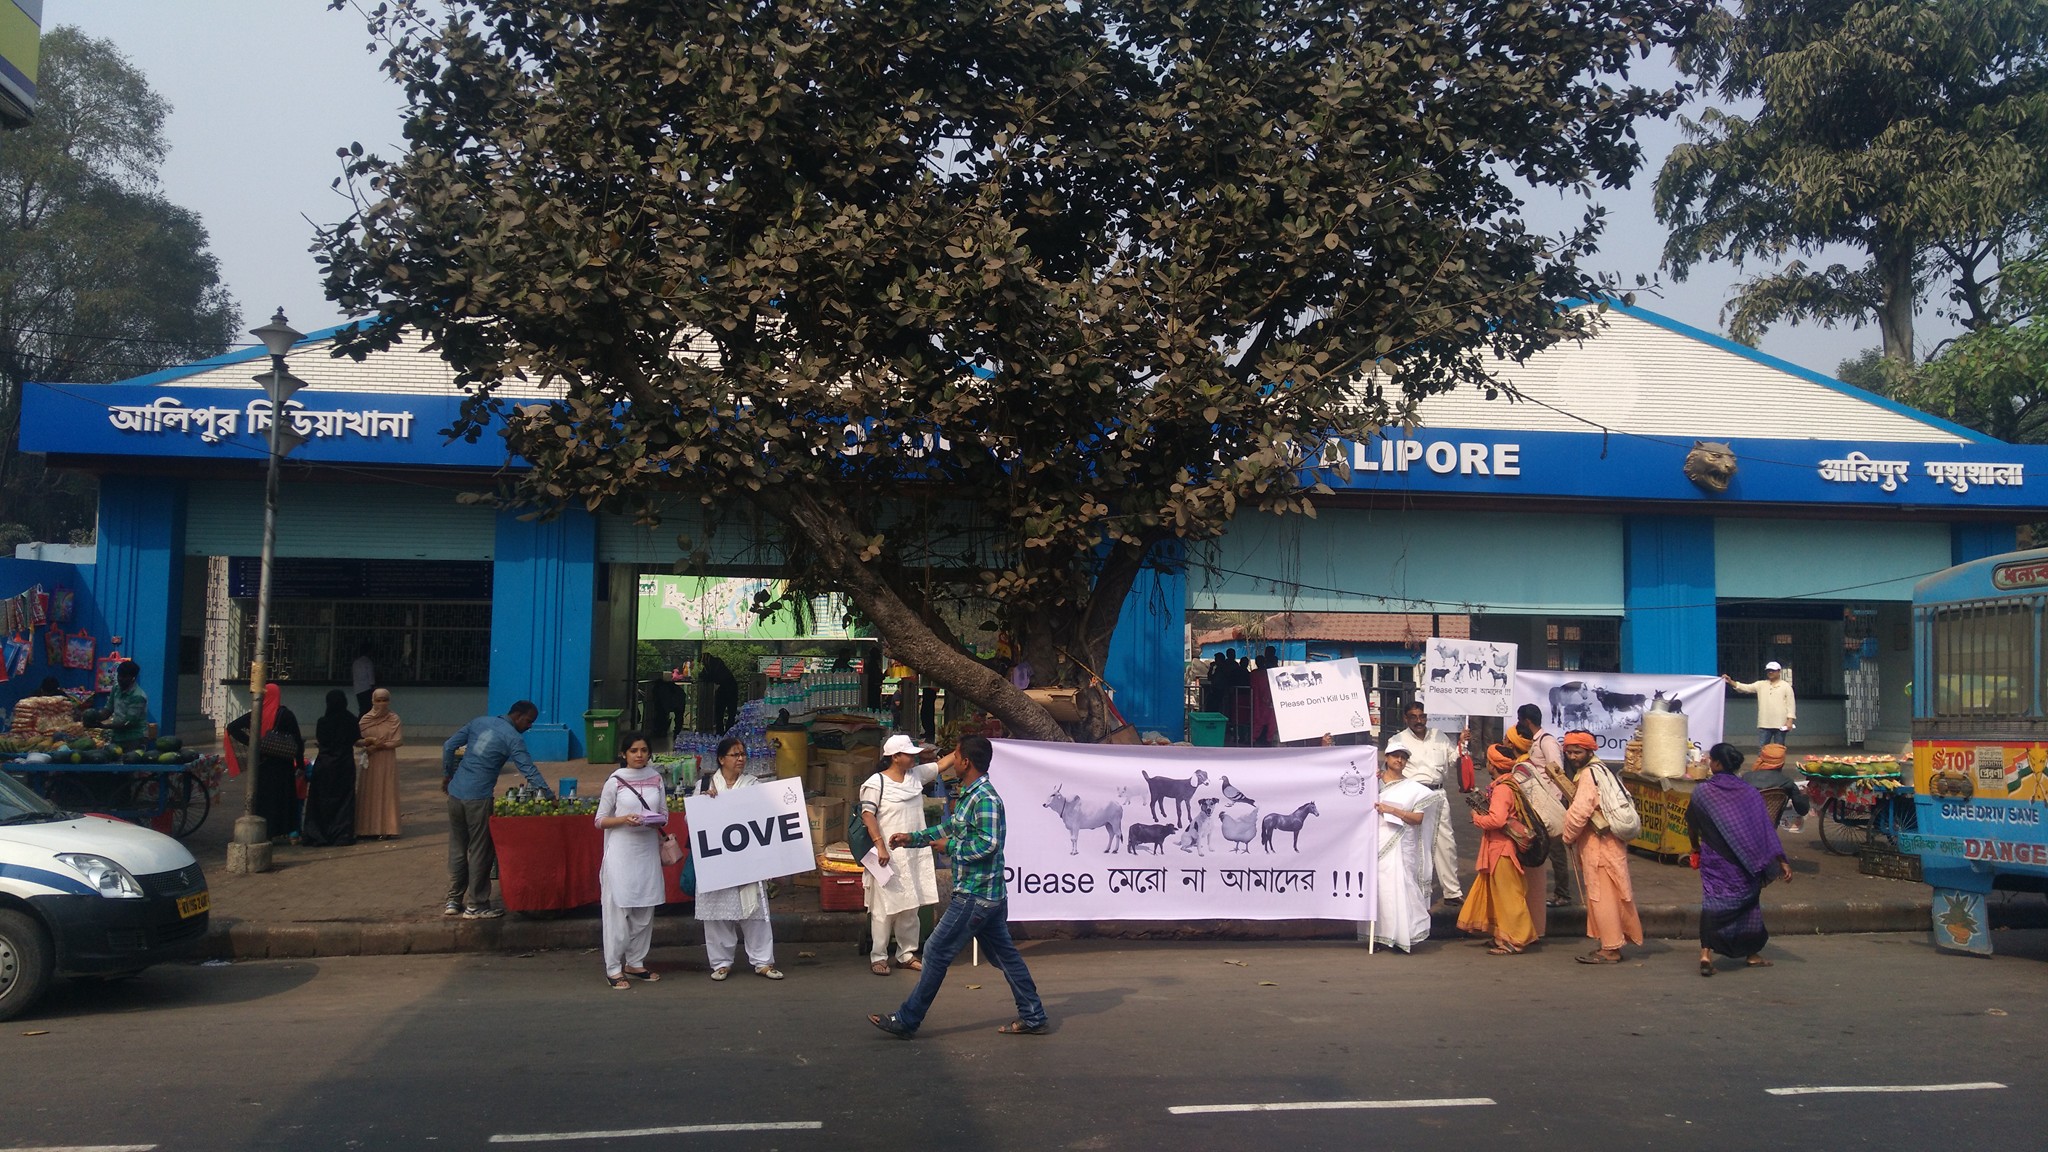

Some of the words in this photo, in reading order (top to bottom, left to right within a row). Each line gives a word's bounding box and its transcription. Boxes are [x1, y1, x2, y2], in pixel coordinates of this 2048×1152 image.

[109, 397, 240, 442] আলিপুর
[1818, 451, 1910, 492] आलिपुर
[1924, 461, 2024, 493] पशुशाला
[1280, 700, 1305, 708] Please
[1306, 697, 1326, 705] Don't
[1327, 694, 1338, 703] Kill
[1429, 686, 1453, 694] Please
[1598, 734, 1633, 749] Don'
[1932, 748, 1975, 772] STOP
[1942, 804, 1974, 819] SAFE
[1976, 806, 2005, 822] DRIV
[697, 812, 803, 858] LOVE
[1107, 867, 1168, 893] মেরো
[1181, 867, 1206, 893] না
[1220, 867, 1316, 893] আমাদের
[1332, 870, 1364, 898] !!!
